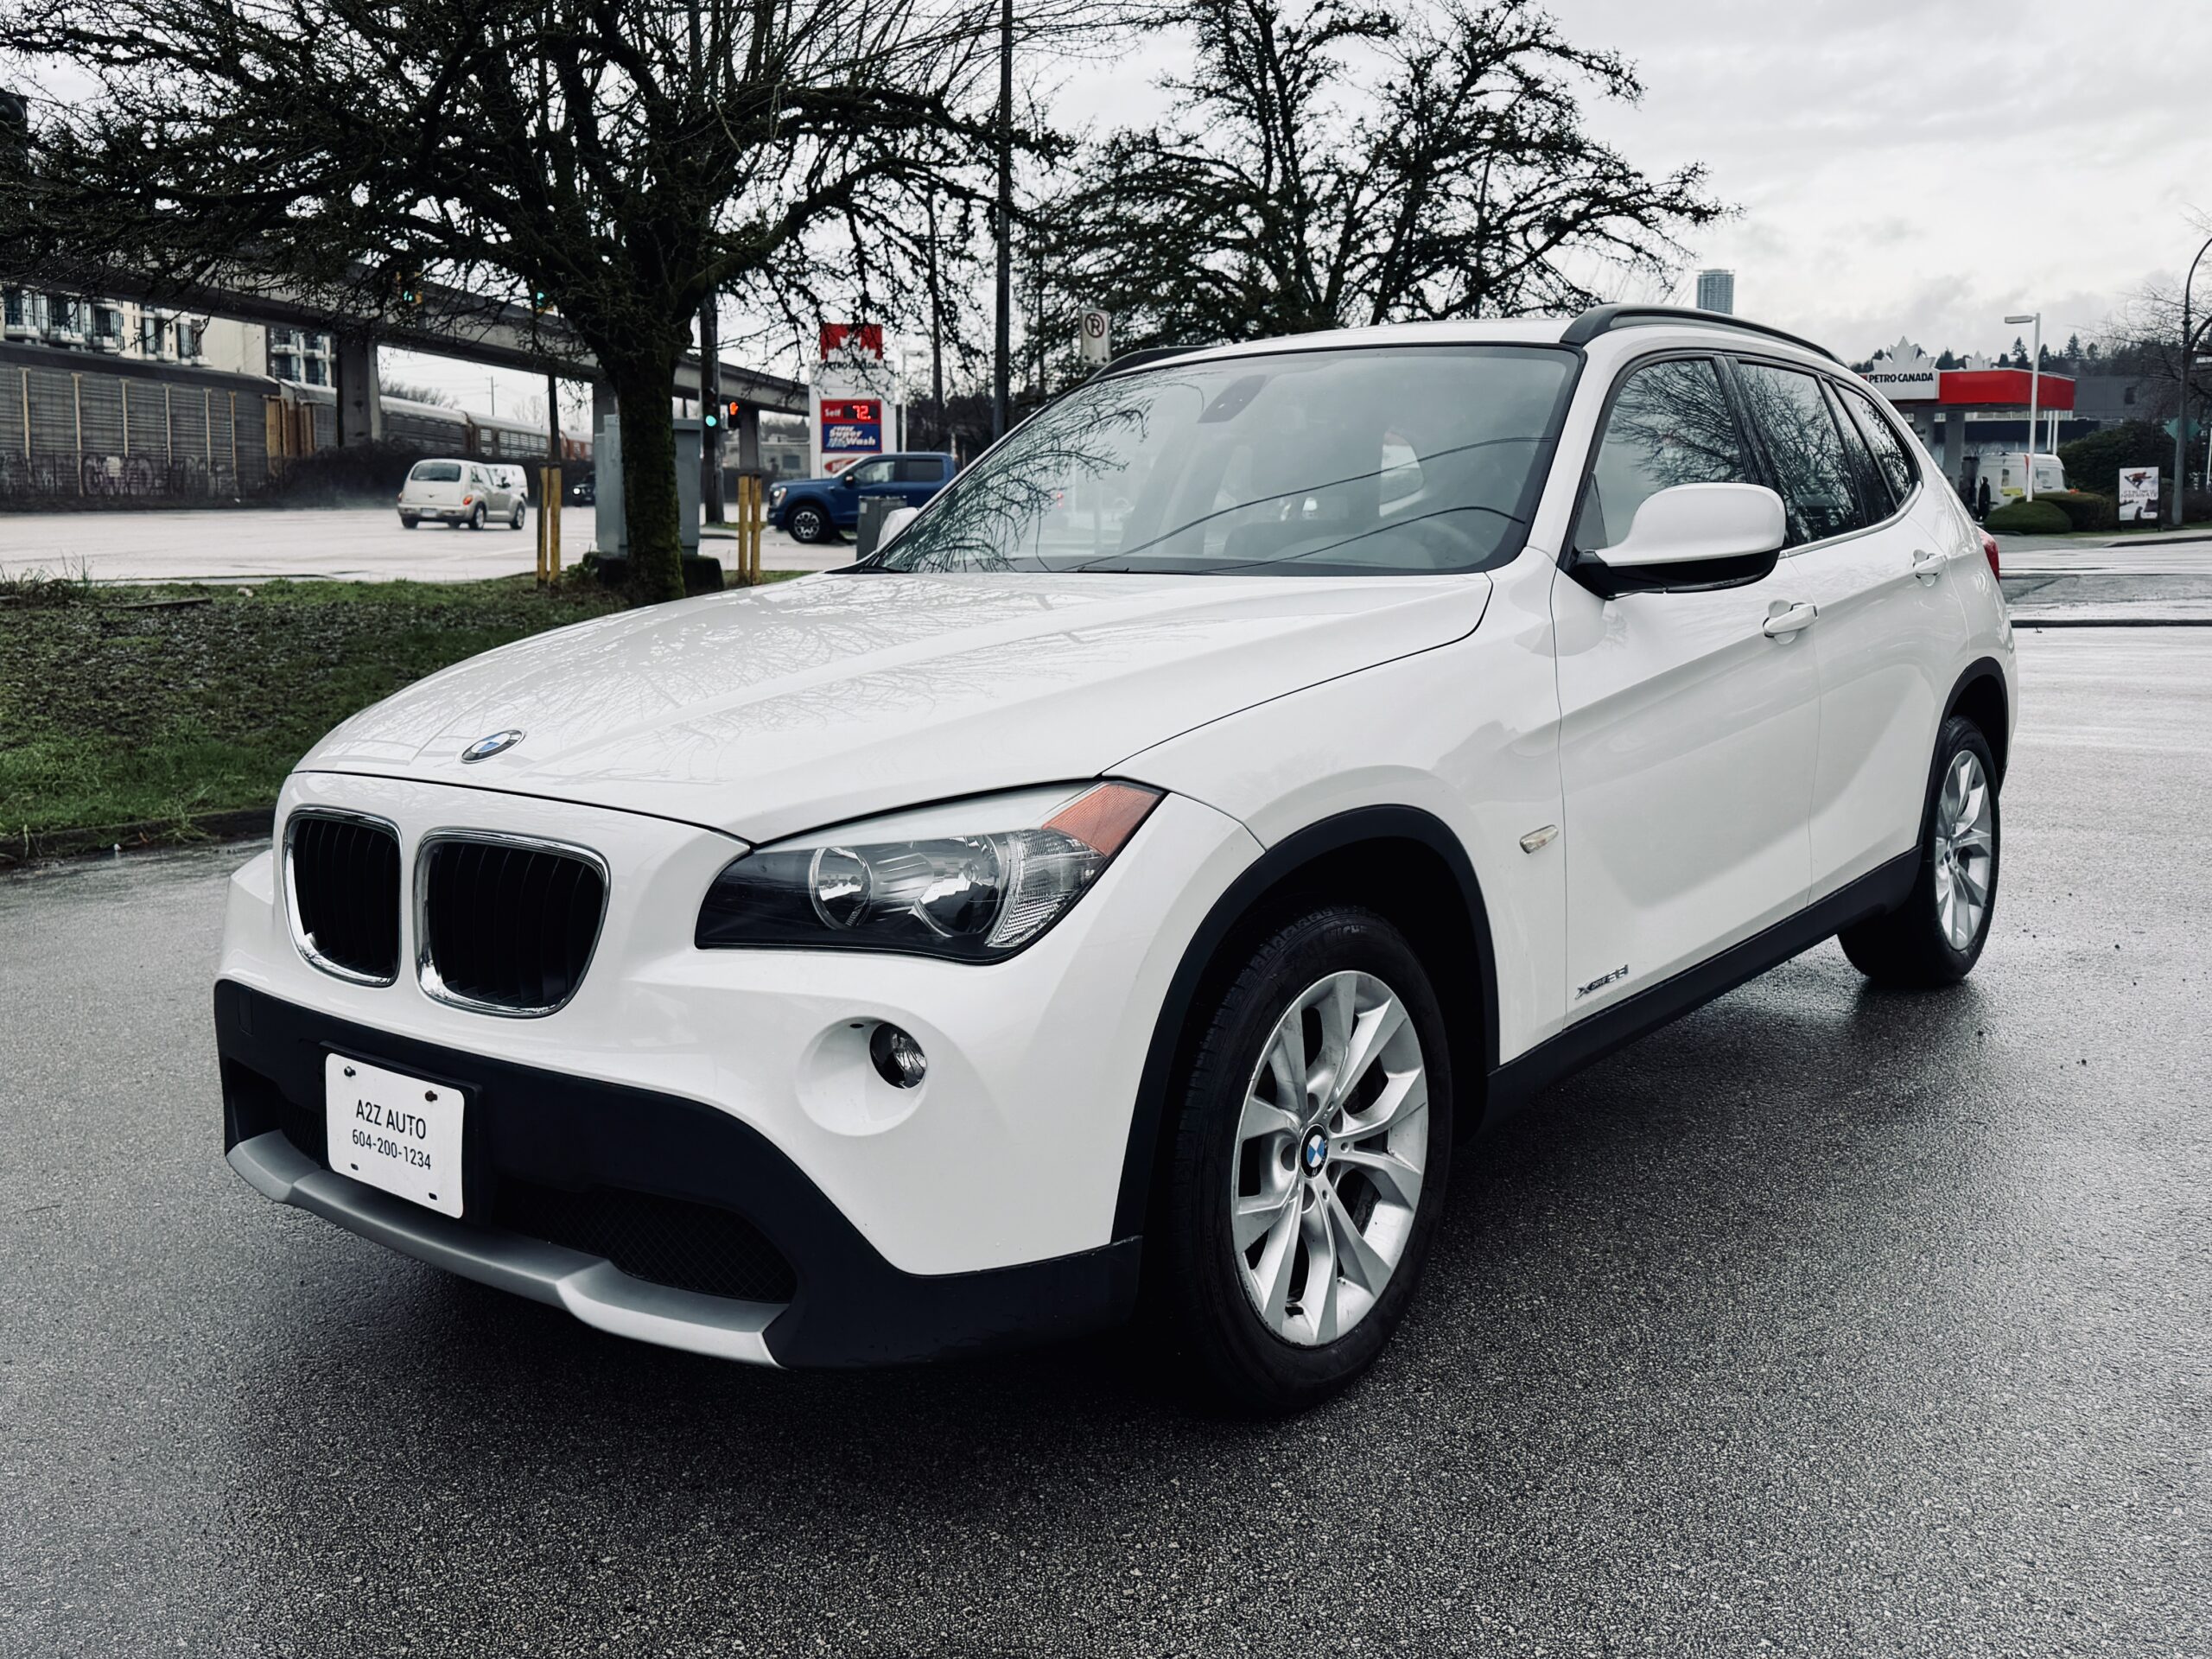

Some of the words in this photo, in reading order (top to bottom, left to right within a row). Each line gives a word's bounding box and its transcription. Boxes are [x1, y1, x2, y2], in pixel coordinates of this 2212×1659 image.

[1869, 374, 1897, 383] PETRO
[1897, 372, 1934, 382] CANADA
[824, 408, 841, 416] Self
[846, 435, 876, 446] Wash
[356, 1099, 382, 1126] A2Z
[386, 1109, 427, 1140] AUTO
[353, 1129, 431, 1170] 604-200-1234
